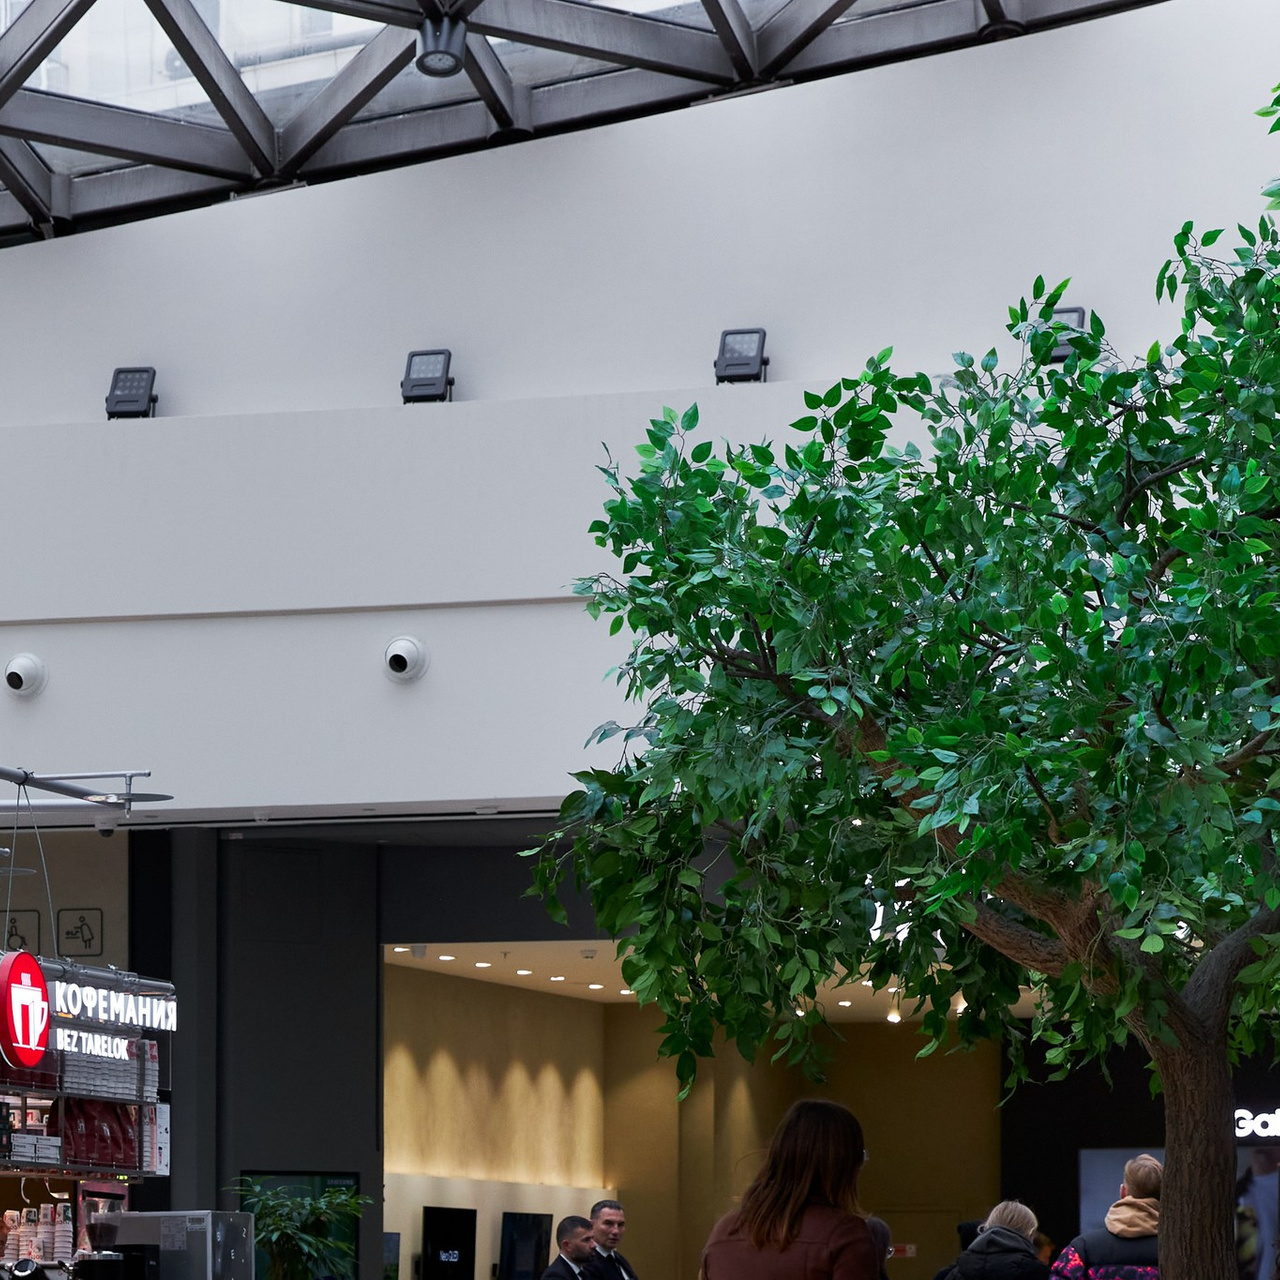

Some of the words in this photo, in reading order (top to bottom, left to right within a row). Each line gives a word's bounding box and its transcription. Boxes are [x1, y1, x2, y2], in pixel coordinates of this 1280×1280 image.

[54, 980, 178, 1032] КОФЕМАНИЯ
[56, 1028, 78, 1053] BEZ
[80, 1031, 130, 1060] TARELOK
